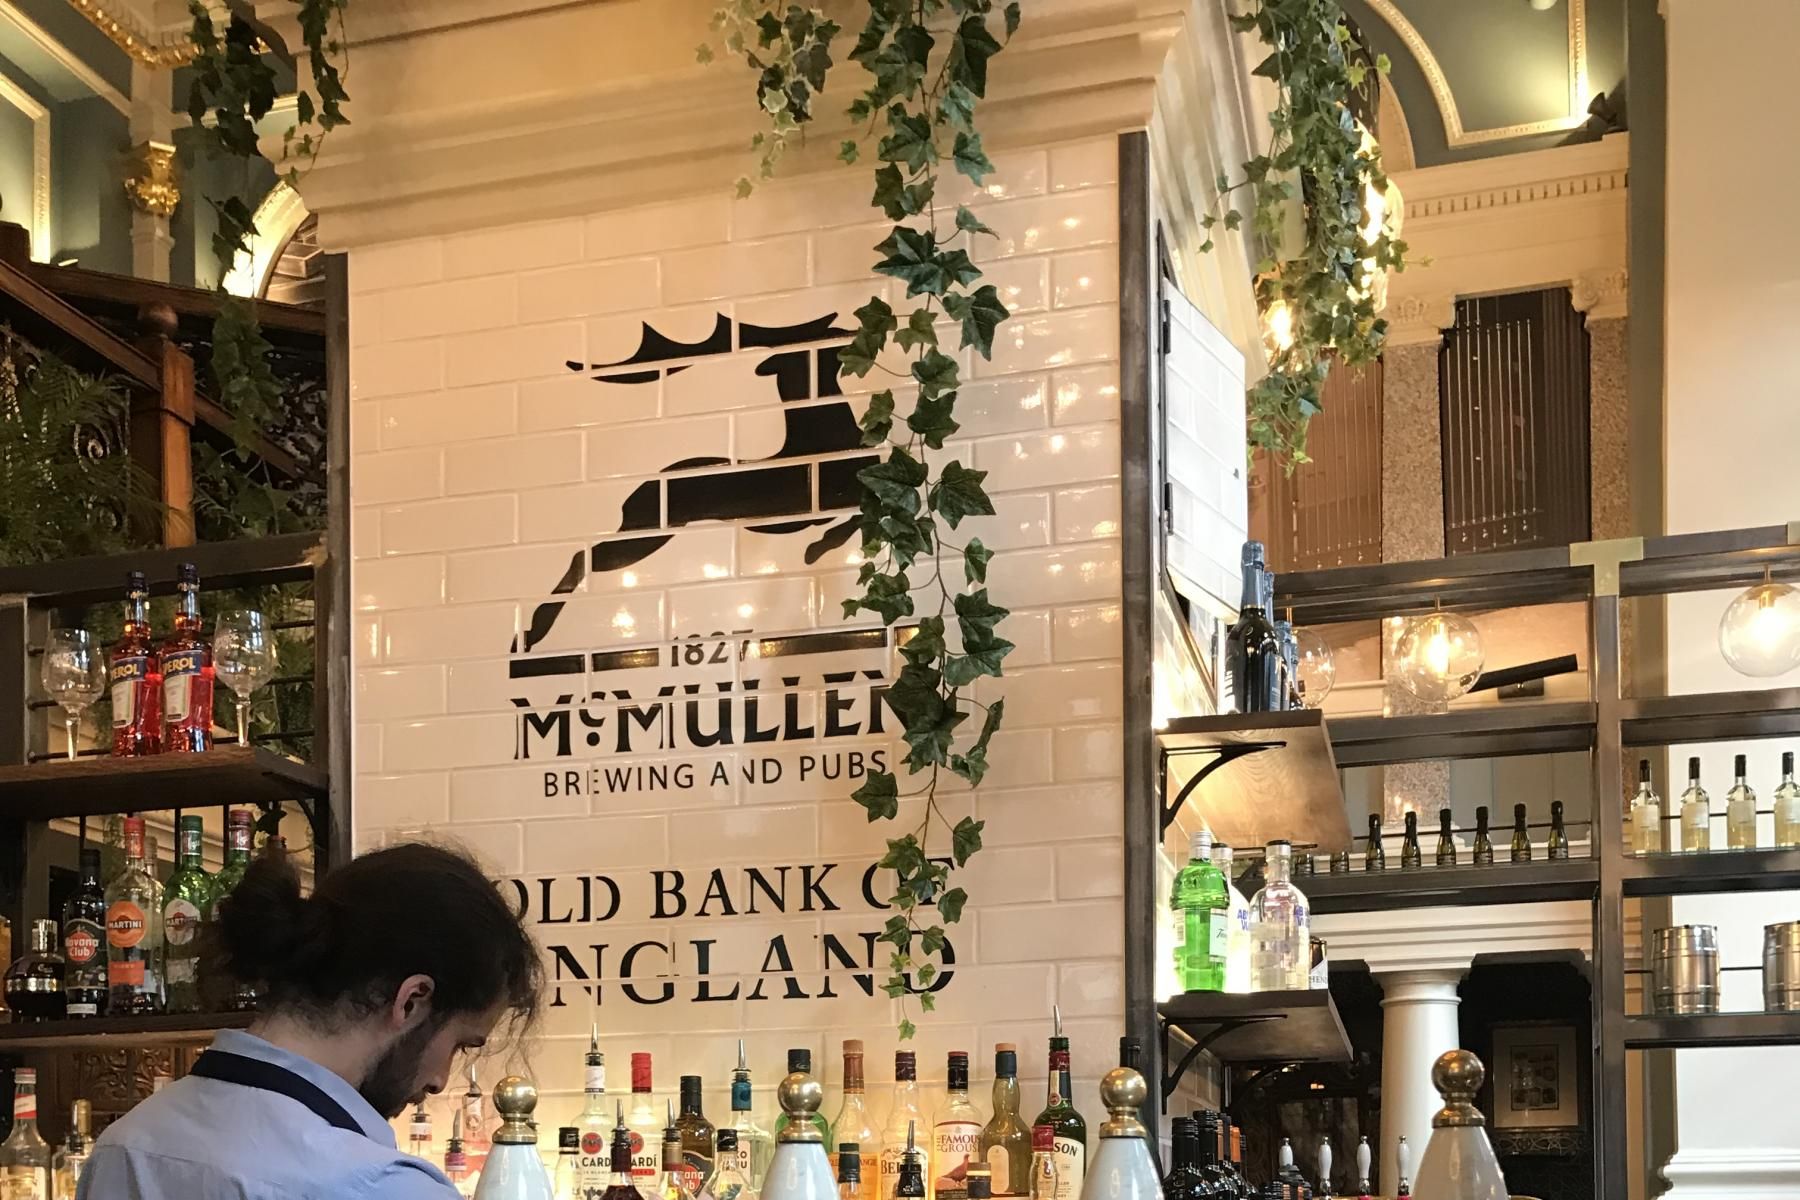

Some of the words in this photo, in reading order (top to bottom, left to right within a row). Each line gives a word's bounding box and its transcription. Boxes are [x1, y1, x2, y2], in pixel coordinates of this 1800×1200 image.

[671, 629, 753, 667] 1827
[543, 761, 695, 798] BREWING
[710, 757, 783, 787] AND
[799, 749, 888, 783] PUBS
[650, 863, 840, 919] BANK
[108, 919, 142, 930] MARTINI
[549, 931, 957, 1007] NGLAND
